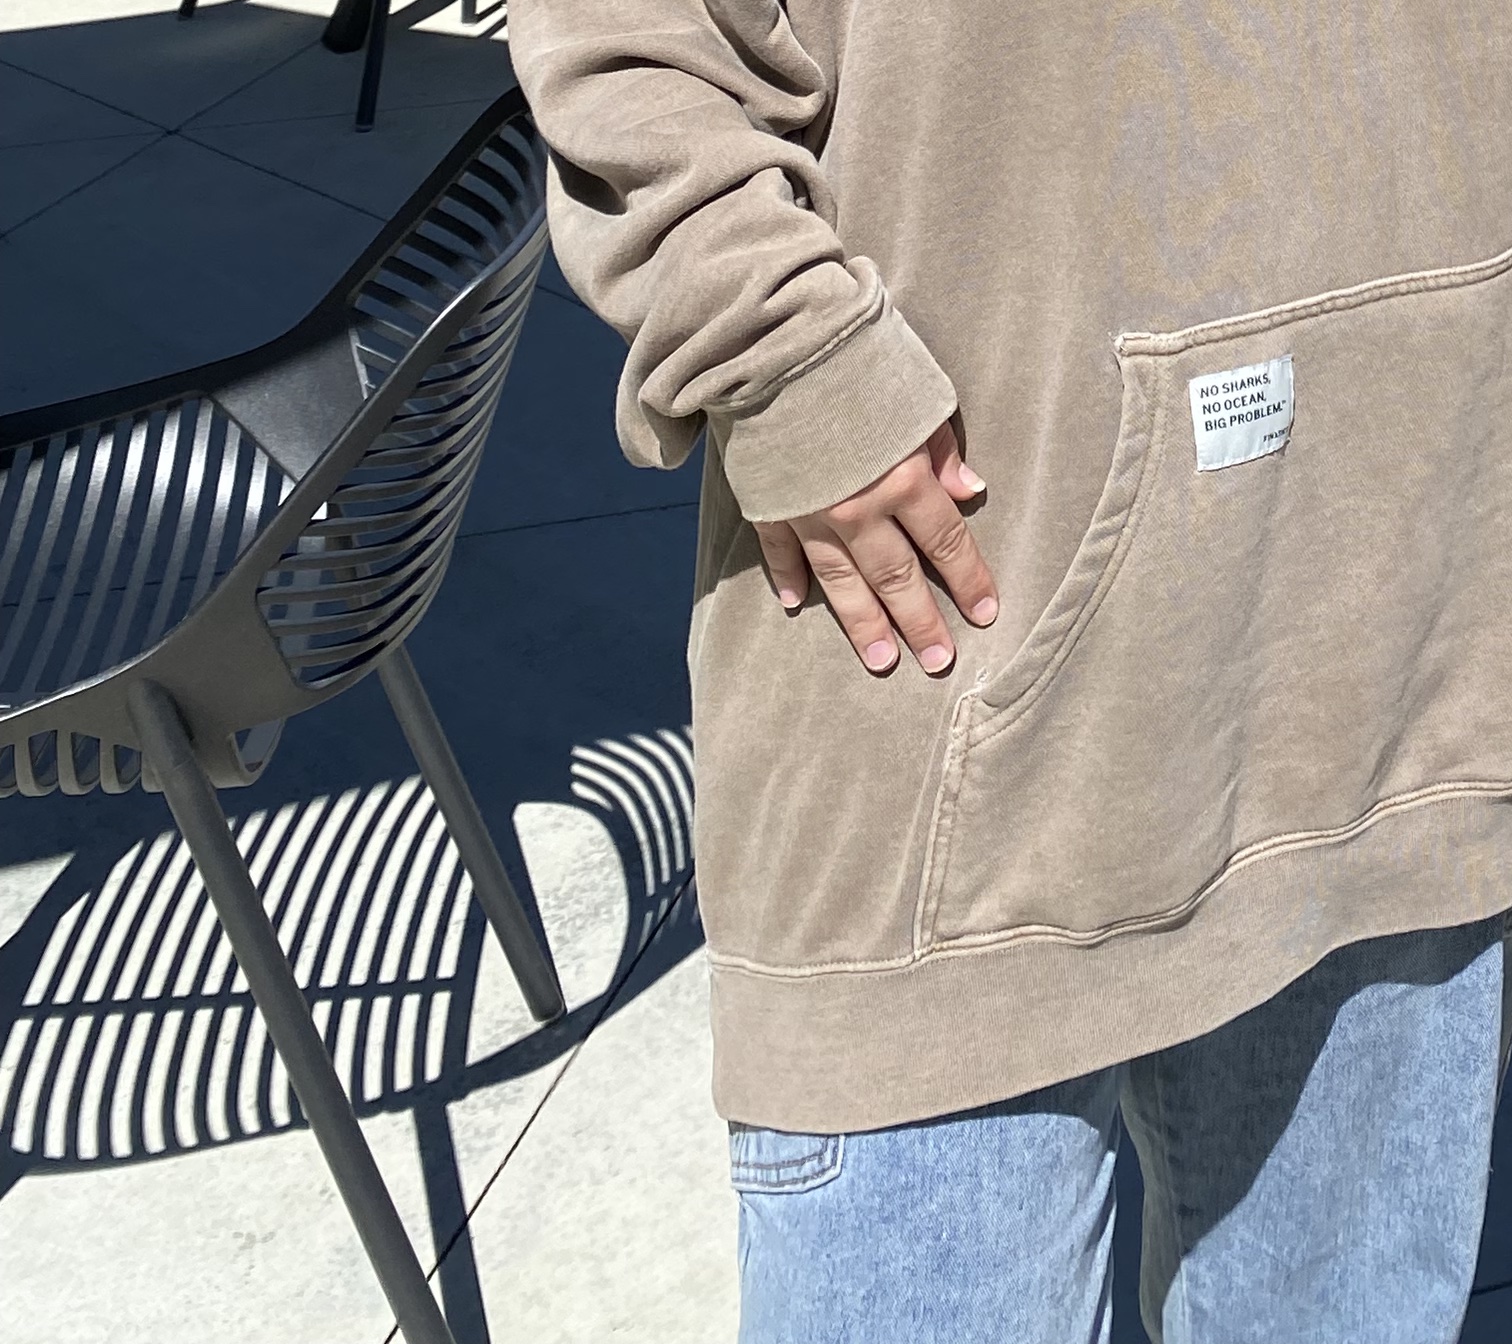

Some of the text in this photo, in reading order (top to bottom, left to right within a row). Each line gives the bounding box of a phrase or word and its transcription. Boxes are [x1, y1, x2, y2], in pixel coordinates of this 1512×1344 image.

[1200, 373, 1271, 398] NO SHARKS,
[1202, 402, 1221, 415] NO
[1205, 418, 1227, 432] BIG
